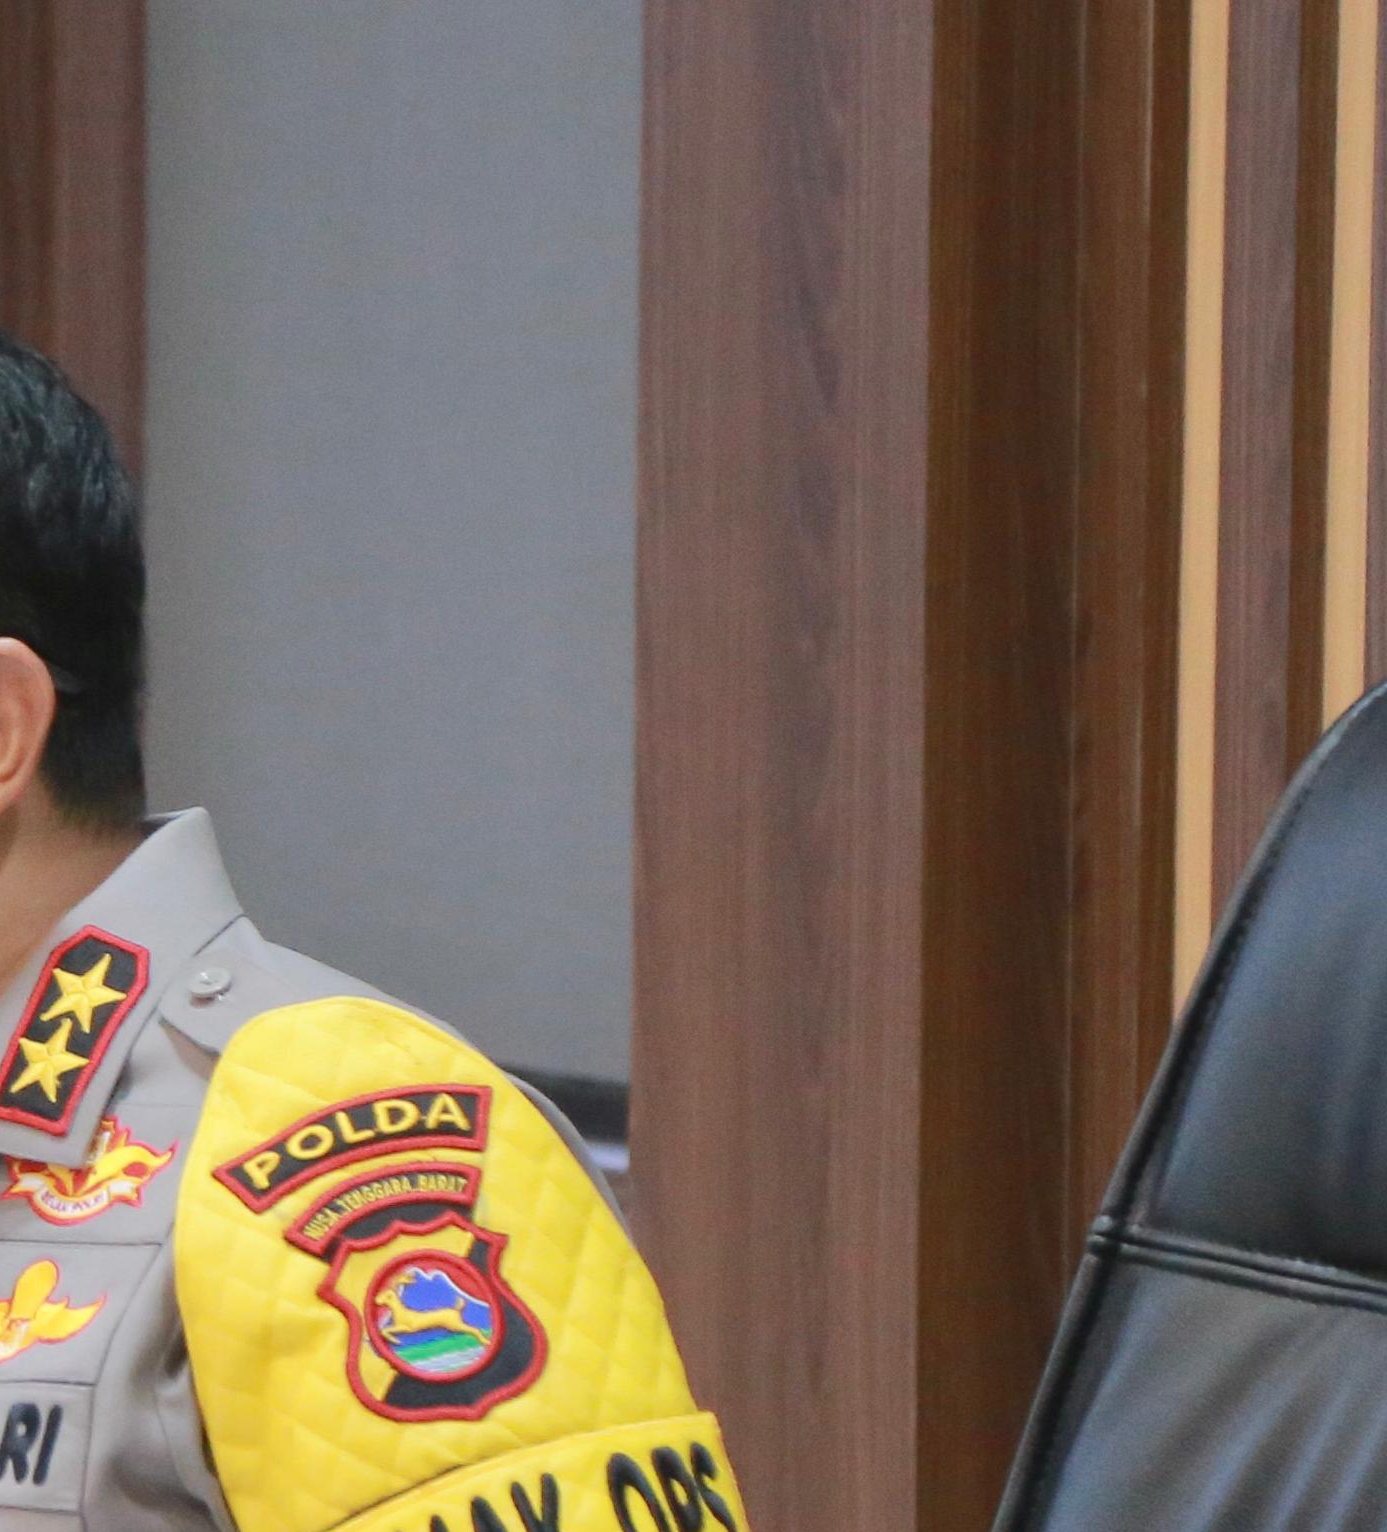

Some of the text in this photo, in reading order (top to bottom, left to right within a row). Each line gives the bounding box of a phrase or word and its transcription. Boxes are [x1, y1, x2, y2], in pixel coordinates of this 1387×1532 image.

[243, 1092, 472, 1190] POLDA
[302, 1206, 342, 1241] NUSA
[417, 1173, 468, 1192] BARAT
